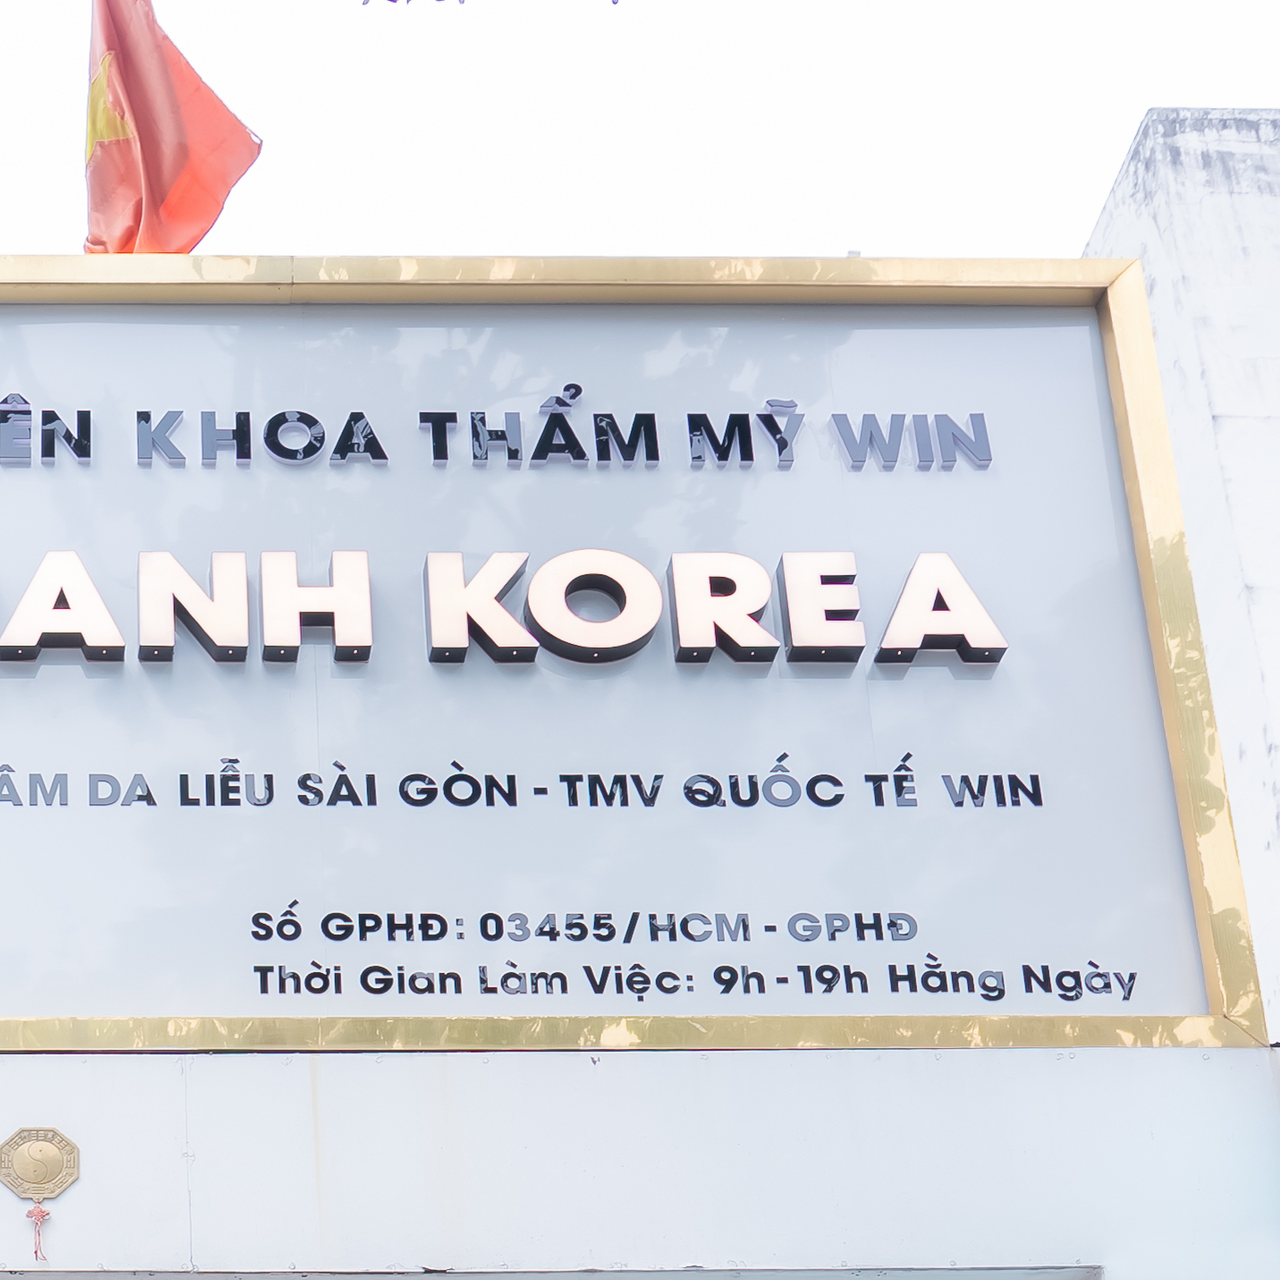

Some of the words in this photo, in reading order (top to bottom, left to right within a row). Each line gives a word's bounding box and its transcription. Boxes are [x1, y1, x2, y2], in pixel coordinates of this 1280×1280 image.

[135, 409, 389, 467] KHOA
[419, 383, 660, 468] THẨM
[687, 398, 805, 469] MỸ
[832, 411, 993, 470] WIN
[423, 547, 1010, 664] KOREA
[87, 774, 154, 807] DA
[178, 757, 274, 807] LIỄU
[296, 760, 378, 807] SÀI
[683, 752, 846, 810] QUỐC
[864, 752, 918, 808] TẾ
[942, 775, 1044, 808] WIN
[250, 899, 302, 942] Số
[320, 911, 465, 942] GPHĐ:
[253, 960, 343, 995] Thời
[360, 964, 462, 995] Gian
[478, 960, 570, 995] Làm
[583, 962, 696, 1002] Việc:
[888, 952, 1006, 1002] Hằng
[1021, 959, 1138, 1002] Ngày
